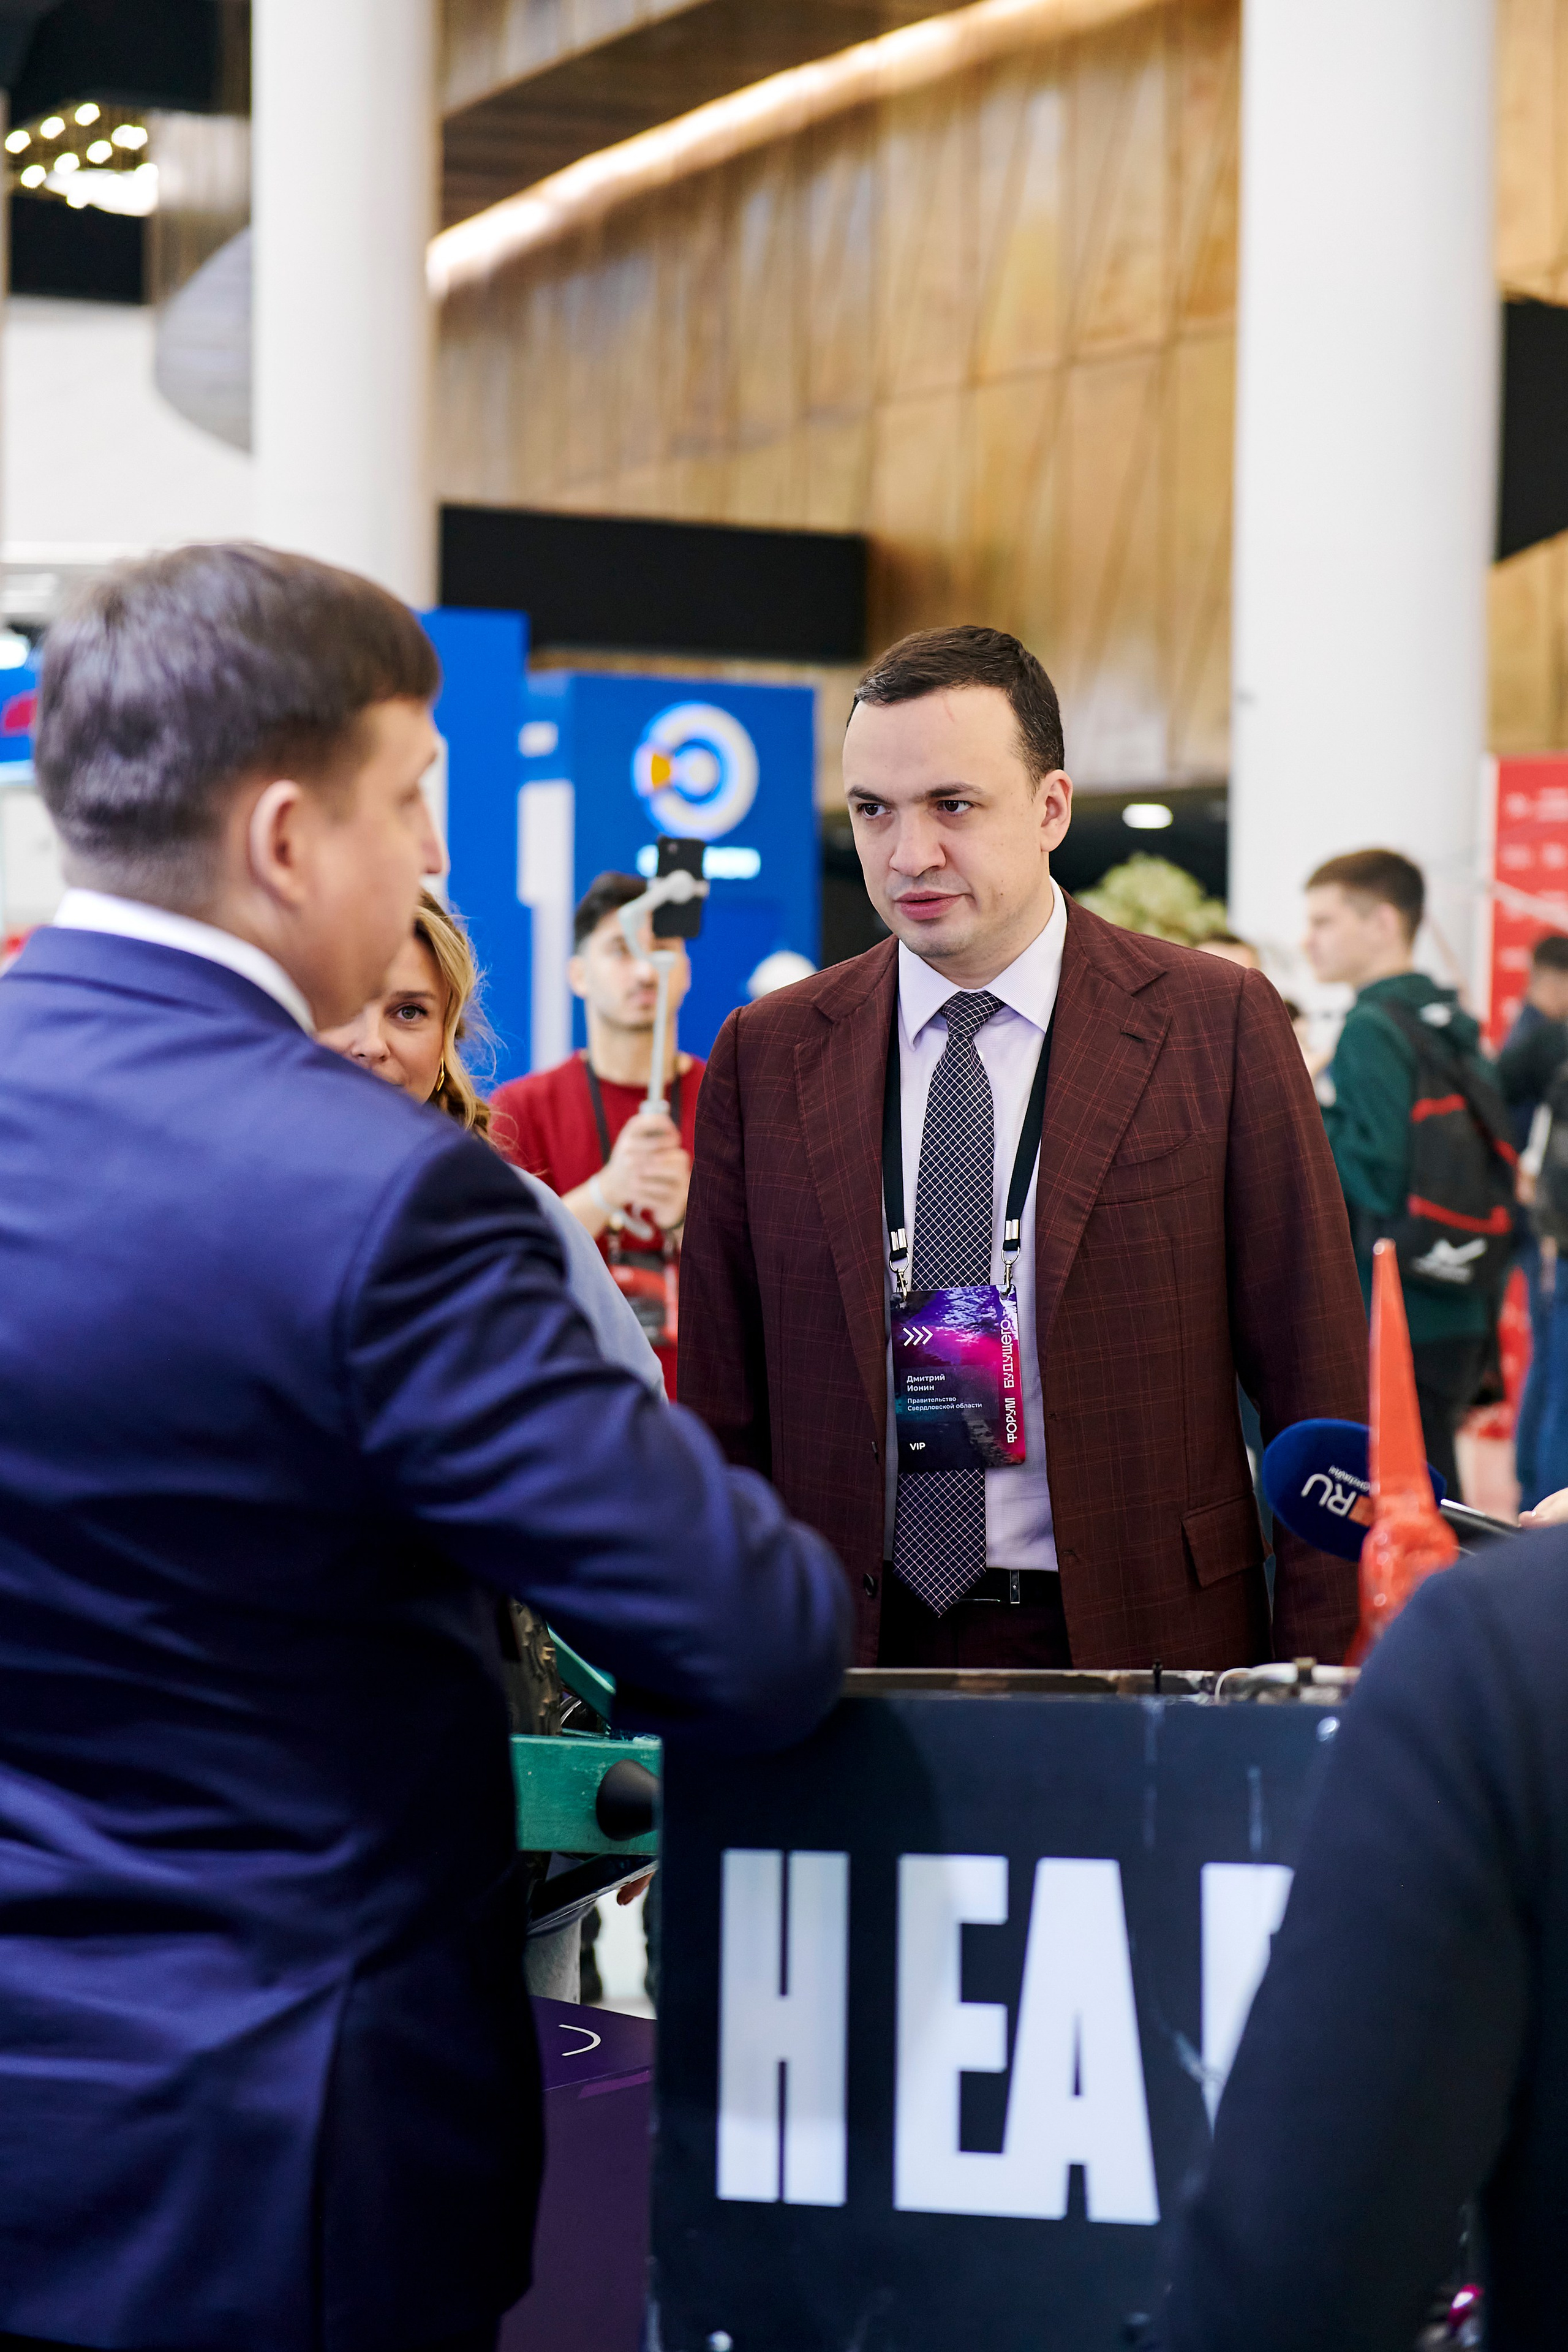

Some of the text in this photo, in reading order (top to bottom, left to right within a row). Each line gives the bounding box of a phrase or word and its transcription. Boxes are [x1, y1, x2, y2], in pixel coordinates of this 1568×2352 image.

[907, 1374, 946, 1384] Дмитрий
[1005, 1397, 1017, 1443] ФОРУМ
[910, 1442, 926, 1450] VIP
